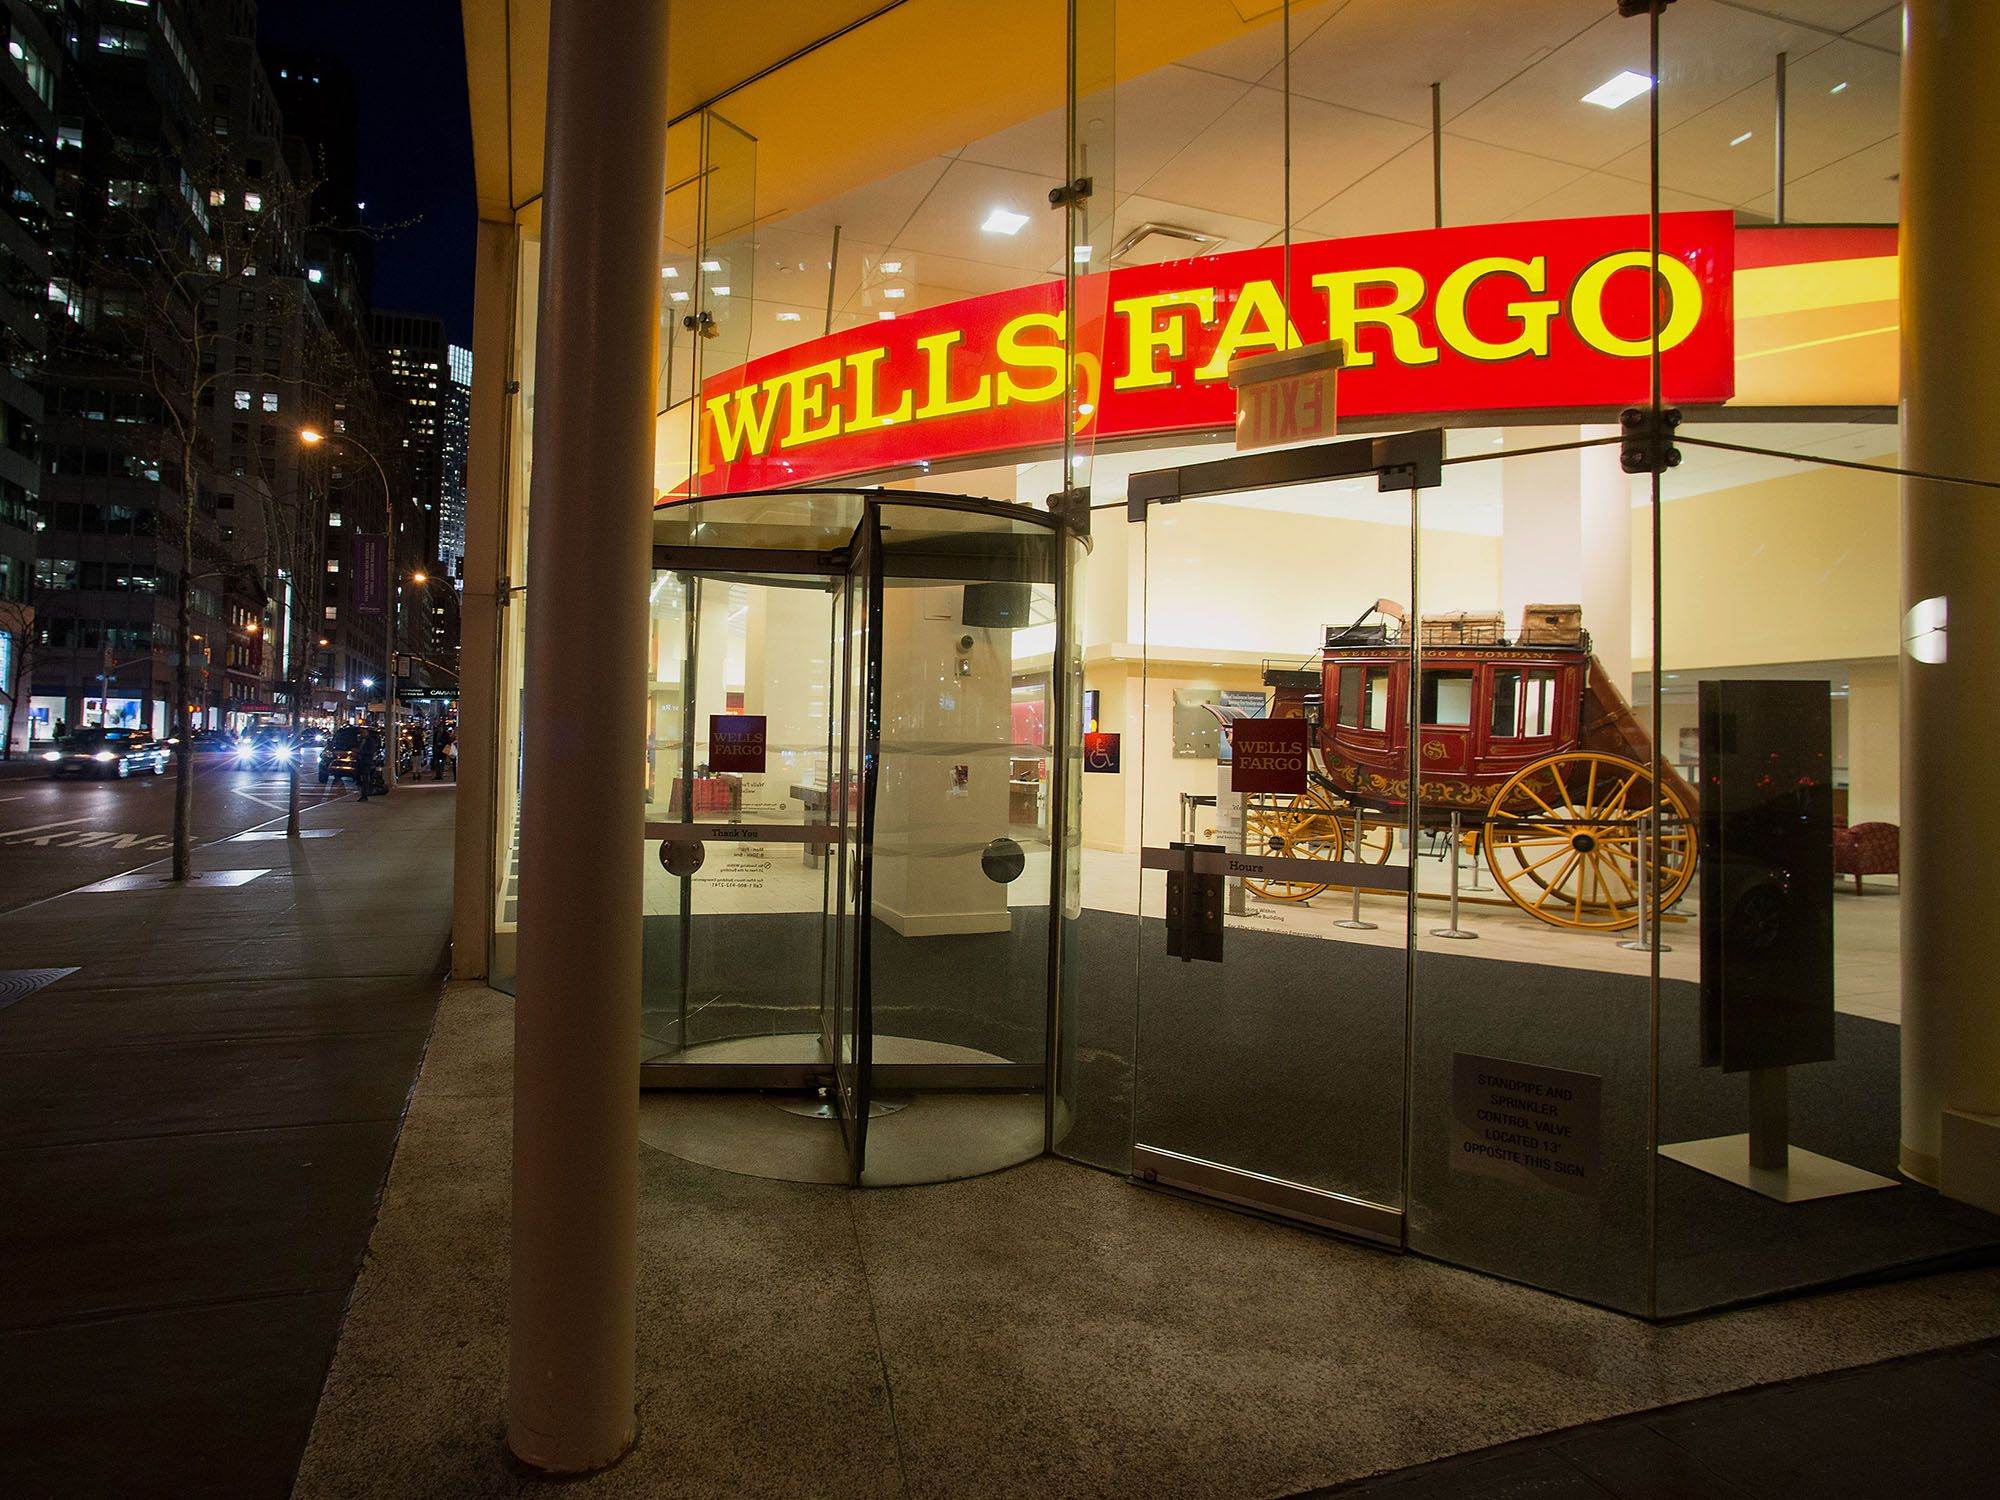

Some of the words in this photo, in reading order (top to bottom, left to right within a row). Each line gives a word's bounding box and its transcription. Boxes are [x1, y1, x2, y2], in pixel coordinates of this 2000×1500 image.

[706, 310, 1070, 462] WELLS
[1113, 248, 1704, 391] FARGO
[1474, 651, 1556, 659] COMPANY
[713, 732, 763, 743] WELLS
[714, 744, 763, 756] FARGO
[1238, 741, 1302, 755] WELLS
[1238, 758, 1302, 771] FARGO
[711, 828, 737, 838] Thank
[737, 829, 758, 838] You
[1229, 860, 1264, 872] Hours
[1263, 914, 1285, 922] Building
[1477, 1073, 1543, 1096] STANDPIPE
[1546, 1087, 1573, 1101] AND
[1490, 1094, 1558, 1116] SPRINKLER
[1477, 1108, 1532, 1130] CONTROL
[1535, 1121, 1572, 1138] VALVE
[1485, 1128, 1538, 1149] LOCATED
[1463, 1141, 1521, 1164] OPPOSITE
[1524, 1153, 1551, 1170] THIS
[1554, 1161, 1585, 1177] SIGN
